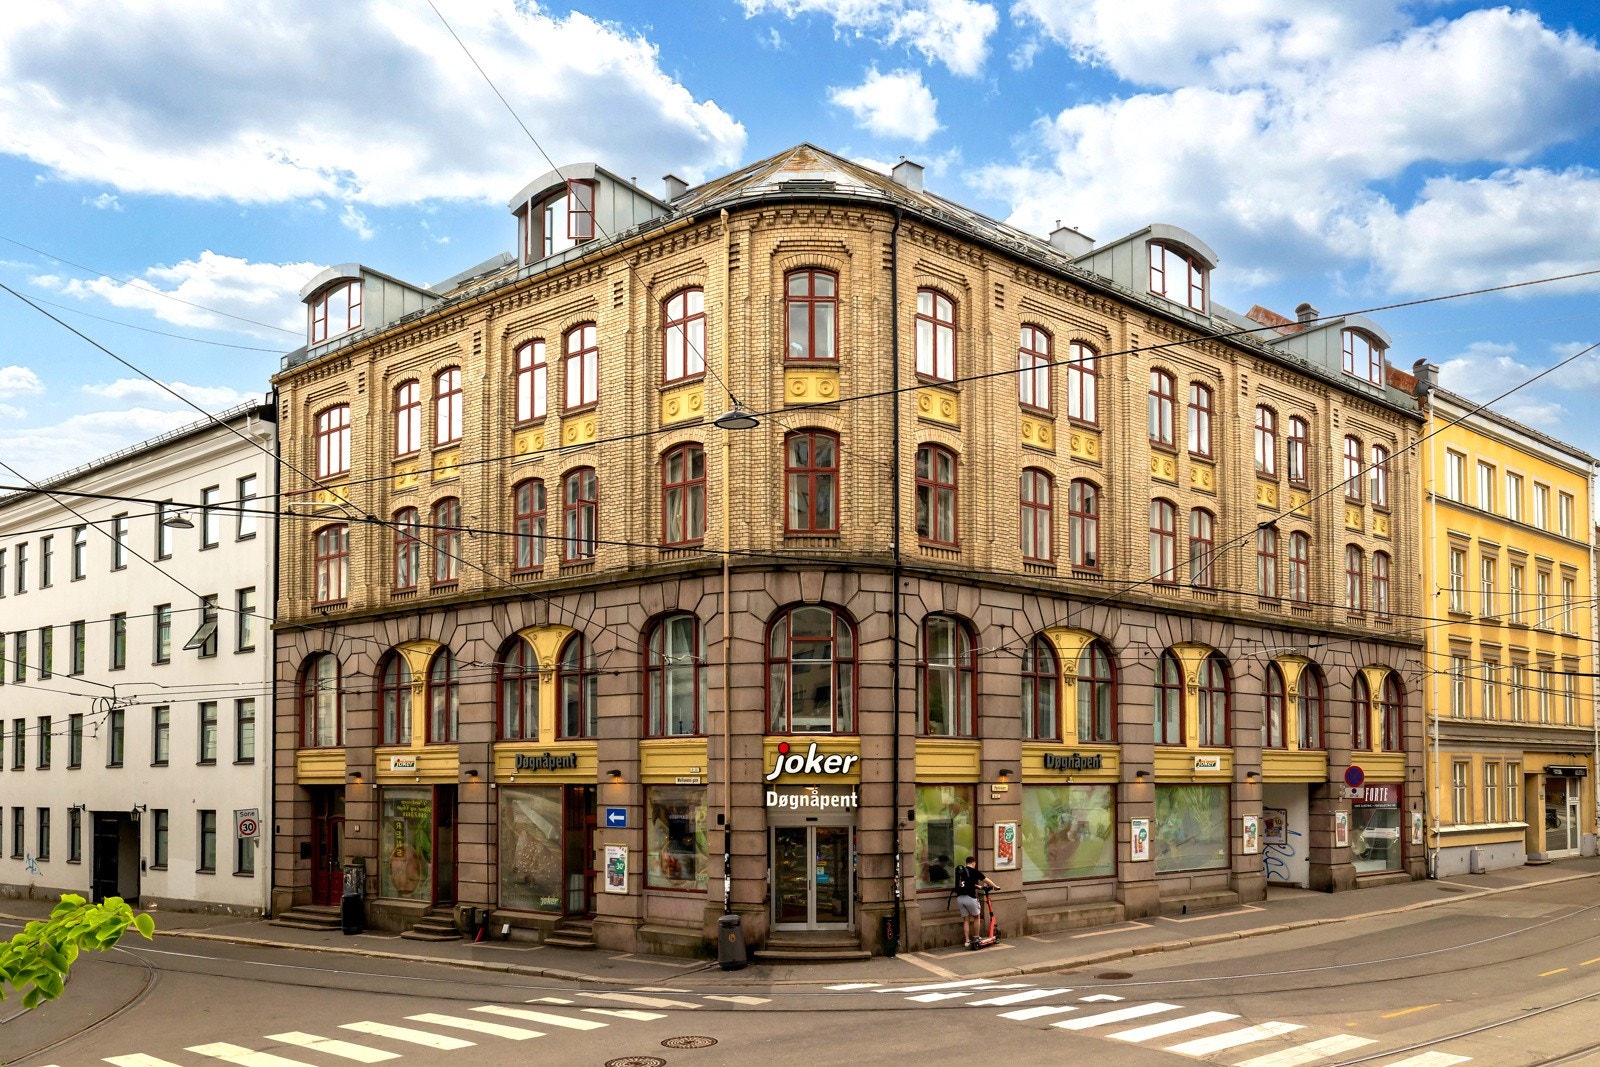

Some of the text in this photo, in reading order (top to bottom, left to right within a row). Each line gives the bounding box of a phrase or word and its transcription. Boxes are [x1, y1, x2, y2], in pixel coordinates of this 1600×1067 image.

[394, 758, 415, 767] joker
[515, 752, 578, 771] Døgnåpent
[766, 742, 858, 781] joker
[1044, 752, 1103, 771] Døgnåpent
[766, 790, 858, 810] Døgnåpent
[1365, 787, 1389, 802] FORTE
[243, 823, 253, 831] 30
